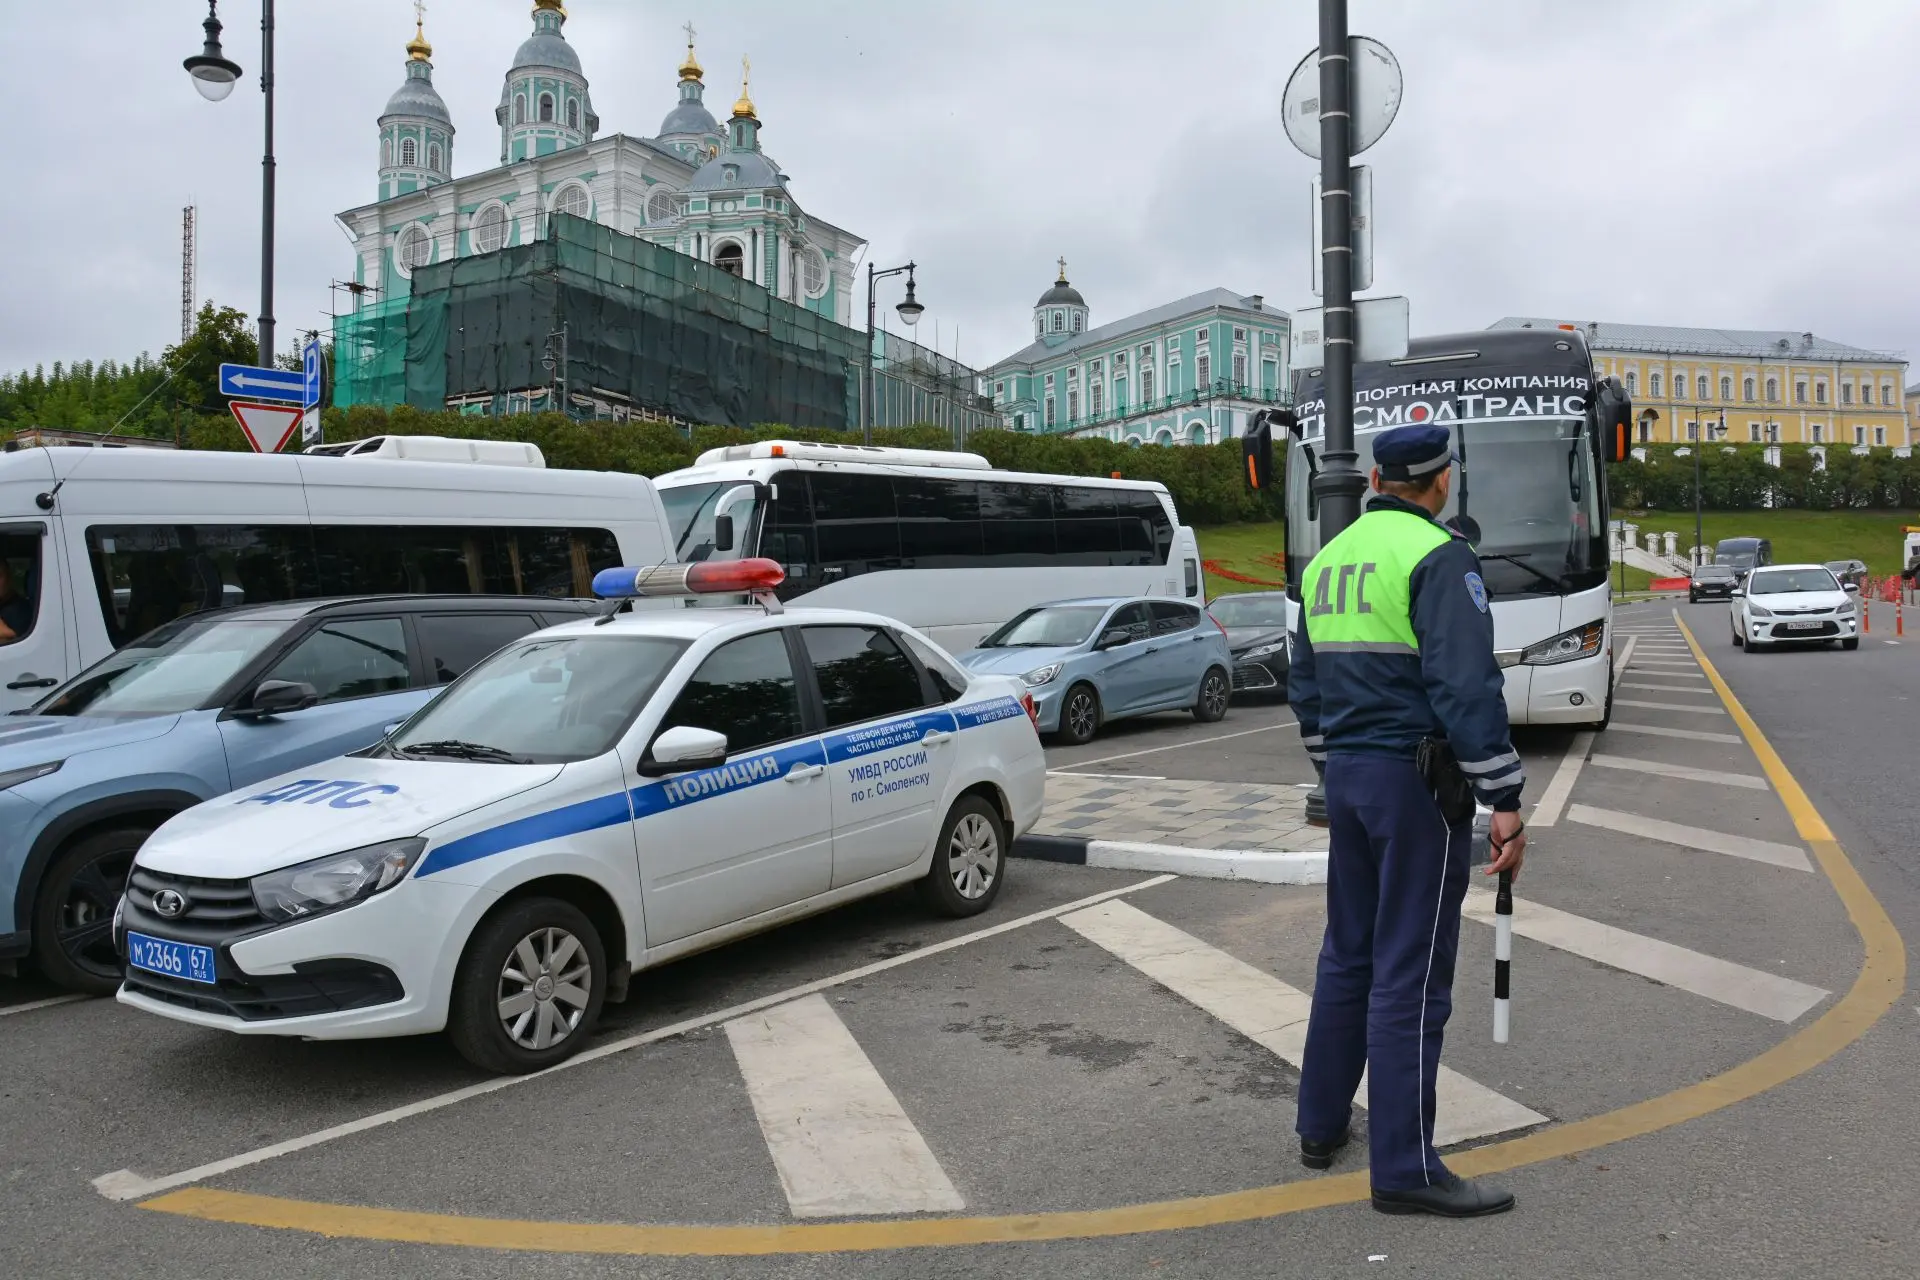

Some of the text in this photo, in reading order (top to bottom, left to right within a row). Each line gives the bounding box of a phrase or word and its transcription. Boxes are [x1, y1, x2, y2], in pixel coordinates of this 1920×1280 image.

[306, 347, 317, 405] P
[1296, 375, 1588, 417] ТРАПОРТНАЯ КОМПАНИЯ
[846, 719, 917, 743] ТЕЛЕФОН ДЕЖУРНОЙ
[846, 740, 871, 754] ЧАСТИ
[875, 736, 895, 750] (4812)
[662, 755, 780, 804] ПОЛИЦИЯ
[848, 750, 928, 784] УМВД РОССИИ
[233, 779, 400, 809] ДПС
[851, 772, 930, 804] по г. Смоленску
[145, 941, 182, 973] 2366
[190, 948, 207, 970] 67
[193, 969, 207, 979] RUS
